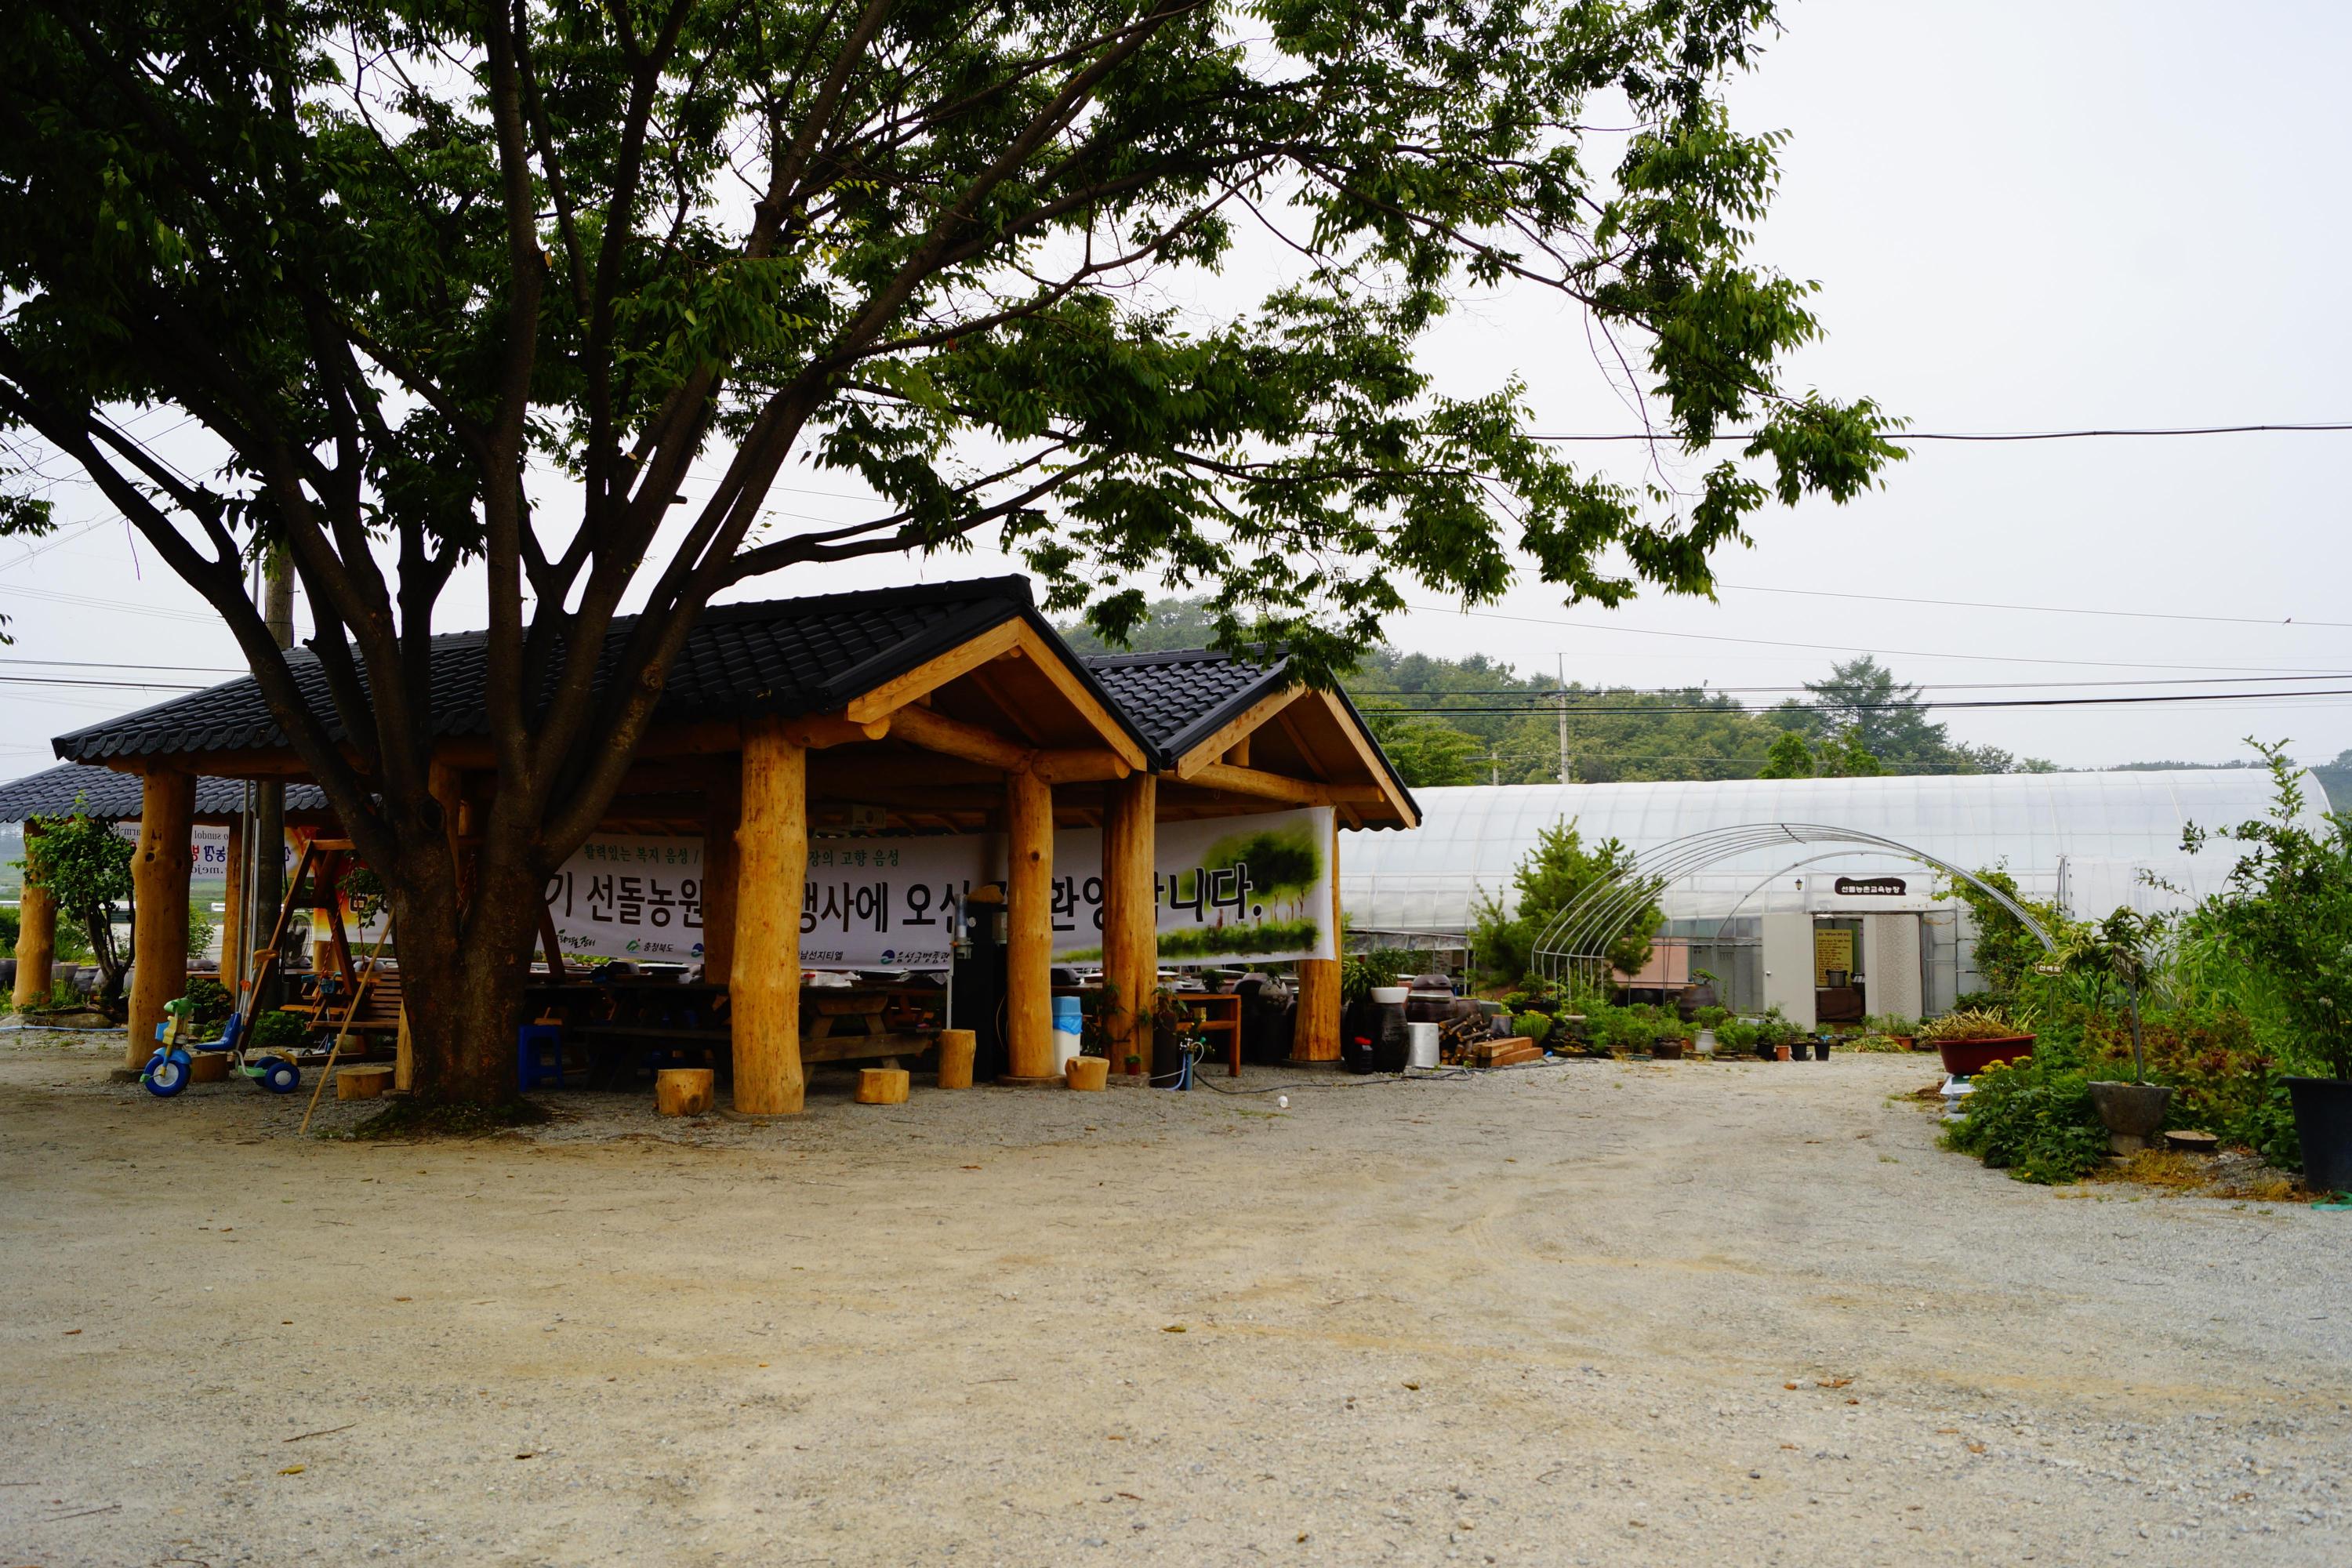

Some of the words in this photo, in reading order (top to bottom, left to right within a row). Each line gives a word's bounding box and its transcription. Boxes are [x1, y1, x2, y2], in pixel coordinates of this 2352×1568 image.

[584, 844, 631, 862] 활력있는
[636, 846, 659, 864] 복지
[664, 847, 688, 866] 음성
[809, 848, 833, 867] 장의
[840, 849, 868, 867] 고향
[873, 848, 899, 867] 음성
[545, 871, 573, 917] 기
[1051, 862, 1262, 932] 환영니다.
[643, 941, 674, 953] 충청북도
[799, 949, 844, 961] 남선지티엘
